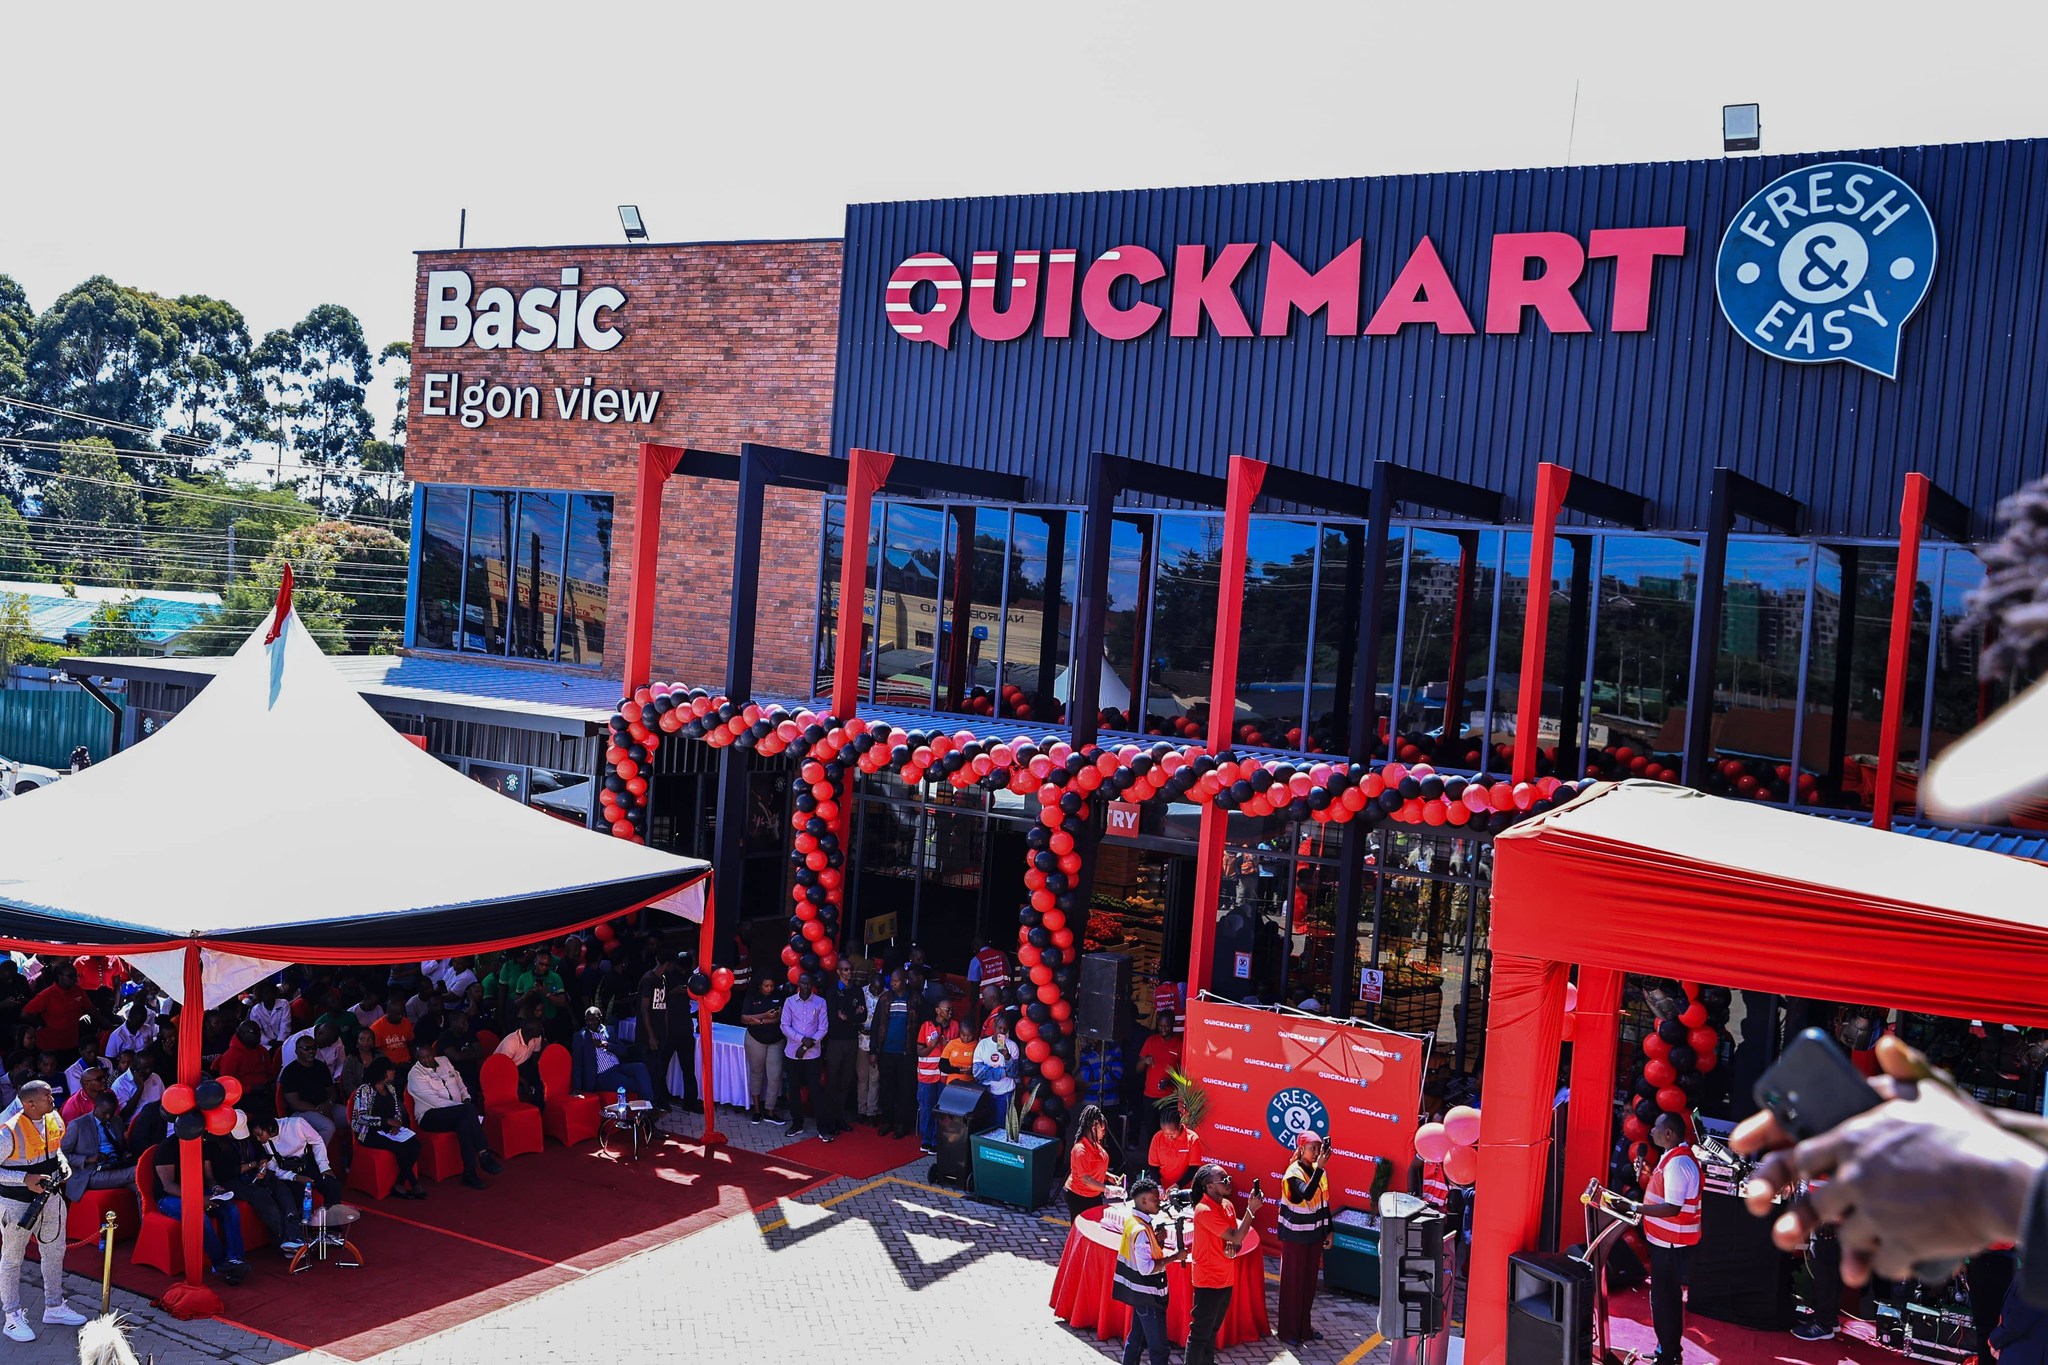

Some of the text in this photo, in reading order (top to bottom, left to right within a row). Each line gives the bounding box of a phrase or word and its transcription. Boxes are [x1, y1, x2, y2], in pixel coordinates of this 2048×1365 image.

[1740, 171, 1910, 247] FRESH
[1798, 235, 1848, 292] &
[885, 225, 1687, 350] QUICKMART
[424, 267, 627, 351] Basic
[1755, 290, 1888, 354] EASY
[423, 372, 661, 428] Elgon view
[1204, 1019, 1243, 1029] QUICKMART
[1278, 1031, 1318, 1043] QUICKMART
[1352, 1044, 1394, 1058] QUICKMART
[1244, 1058, 1284, 1070] QUICKMART
[1202, 1077, 1241, 1090] QUICKMART
[1319, 1071, 1359, 1085] QUICKMART
[1272, 1090, 1322, 1115] FRESH
[1290, 1110, 1305, 1130] &
[1349, 1106, 1391, 1120] QUICKMART
[1214, 1123, 1253, 1136] QUICKMART
[1278, 1129, 1297, 1149] EA
[1332, 1148, 1374, 1162] QUICKMART
